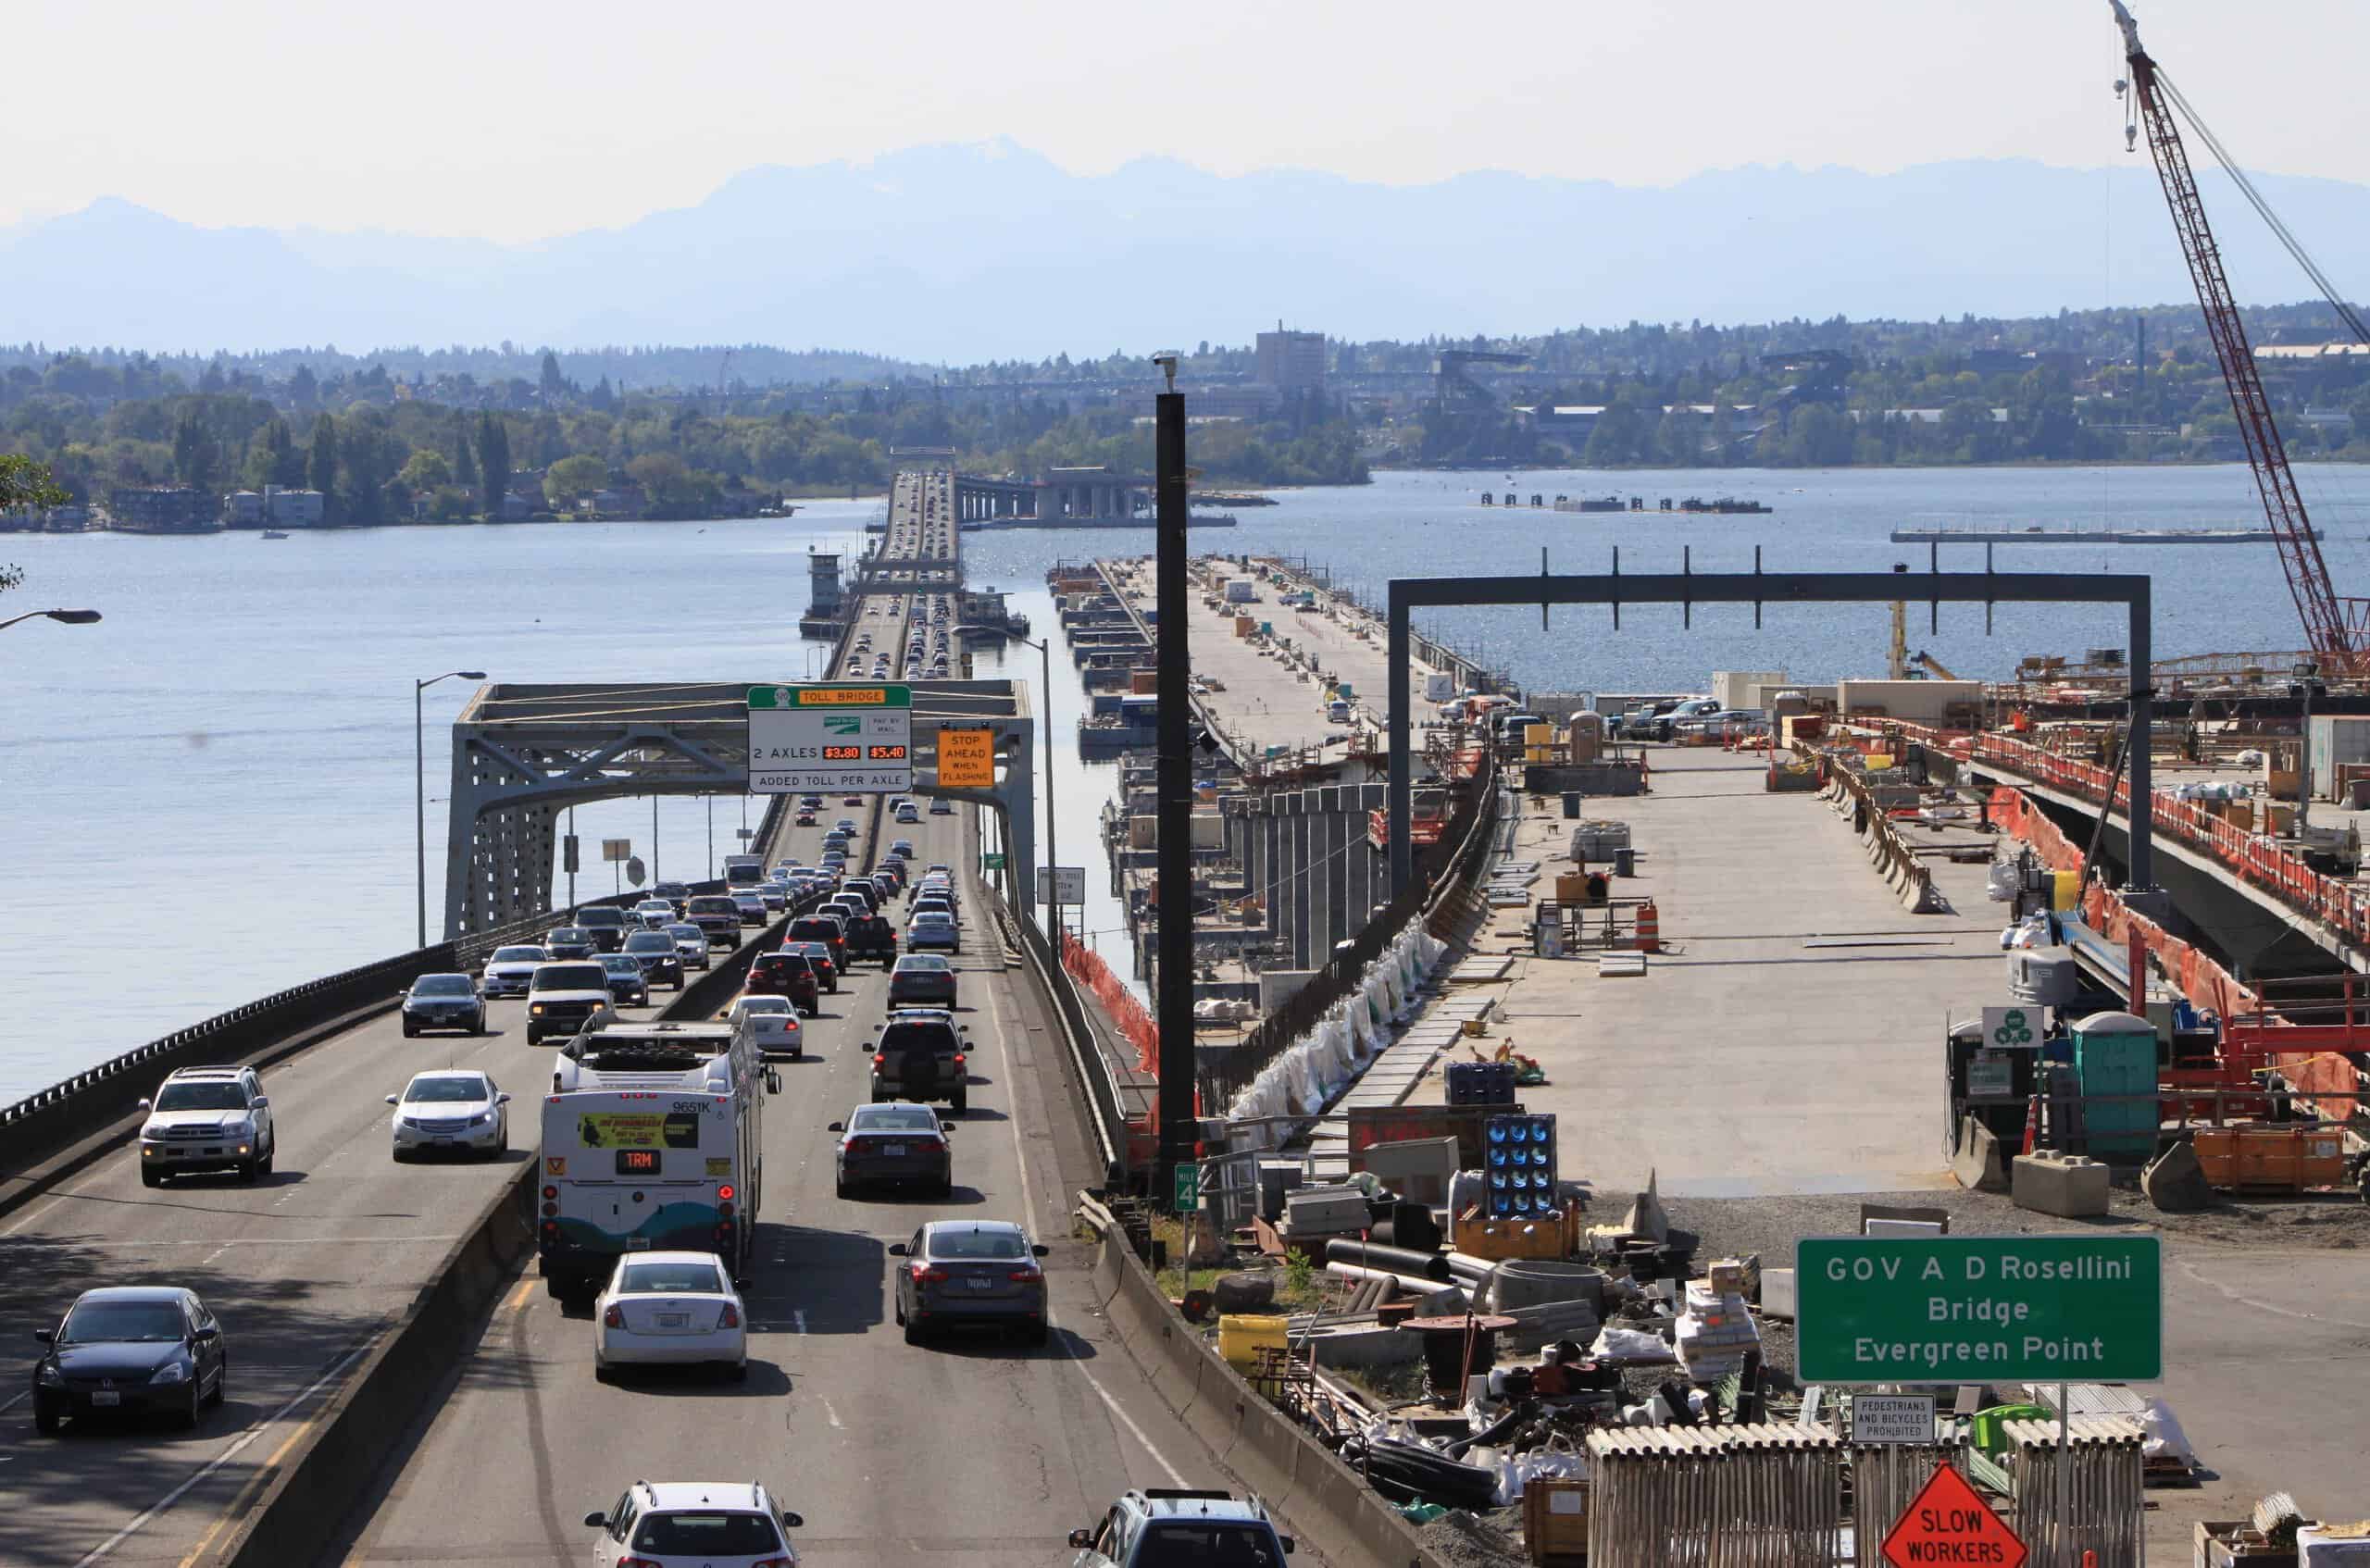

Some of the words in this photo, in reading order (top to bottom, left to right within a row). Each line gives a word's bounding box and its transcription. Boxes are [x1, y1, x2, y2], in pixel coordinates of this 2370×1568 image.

[804, 691, 830, 702] TOLL
[837, 691, 882, 702] BRIDGE
[952, 736, 979, 745] STOP
[754, 748, 763, 759] 2
[770, 747, 817, 758] AXLES
[824, 747, 859, 758] $3.80
[870, 746, 904, 758] $5.40
[946, 749, 985, 759] AHEAD
[953, 762, 979, 770] WHEN
[759, 777, 800, 786] ADDED
[807, 777, 834, 786] TOLL
[842, 776, 864, 785] PER
[871, 776, 903, 785] AXLE
[942, 772, 989, 781] FLASHING
[673, 1101, 711, 1113] 9651K
[627, 1153, 652, 1168] TRM
[1179, 1173, 1195, 1183] MILE
[1179, 1185, 1194, 1205] 4
[1827, 1257, 1902, 1281] GOV
[1921, 1257, 1944, 1280] A
[1966, 1256, 1987, 1279] D
[2001, 1255, 2132, 1280] Rosellini
[1928, 1297, 2029, 1327] Bridge
[1855, 1338, 2008, 1368] Evergreen
[2023, 1337, 2104, 1361] Point
[1862, 1401, 1926, 1412] PEDESTRIANS
[1858, 1413, 1877, 1424] AND
[1882, 1413, 1927, 1424] BICYCLES
[1866, 1426, 1922, 1437] PROHIBITED
[1921, 1510, 1982, 1533] SLOW
[1907, 1541, 2004, 1563] WORKERS
